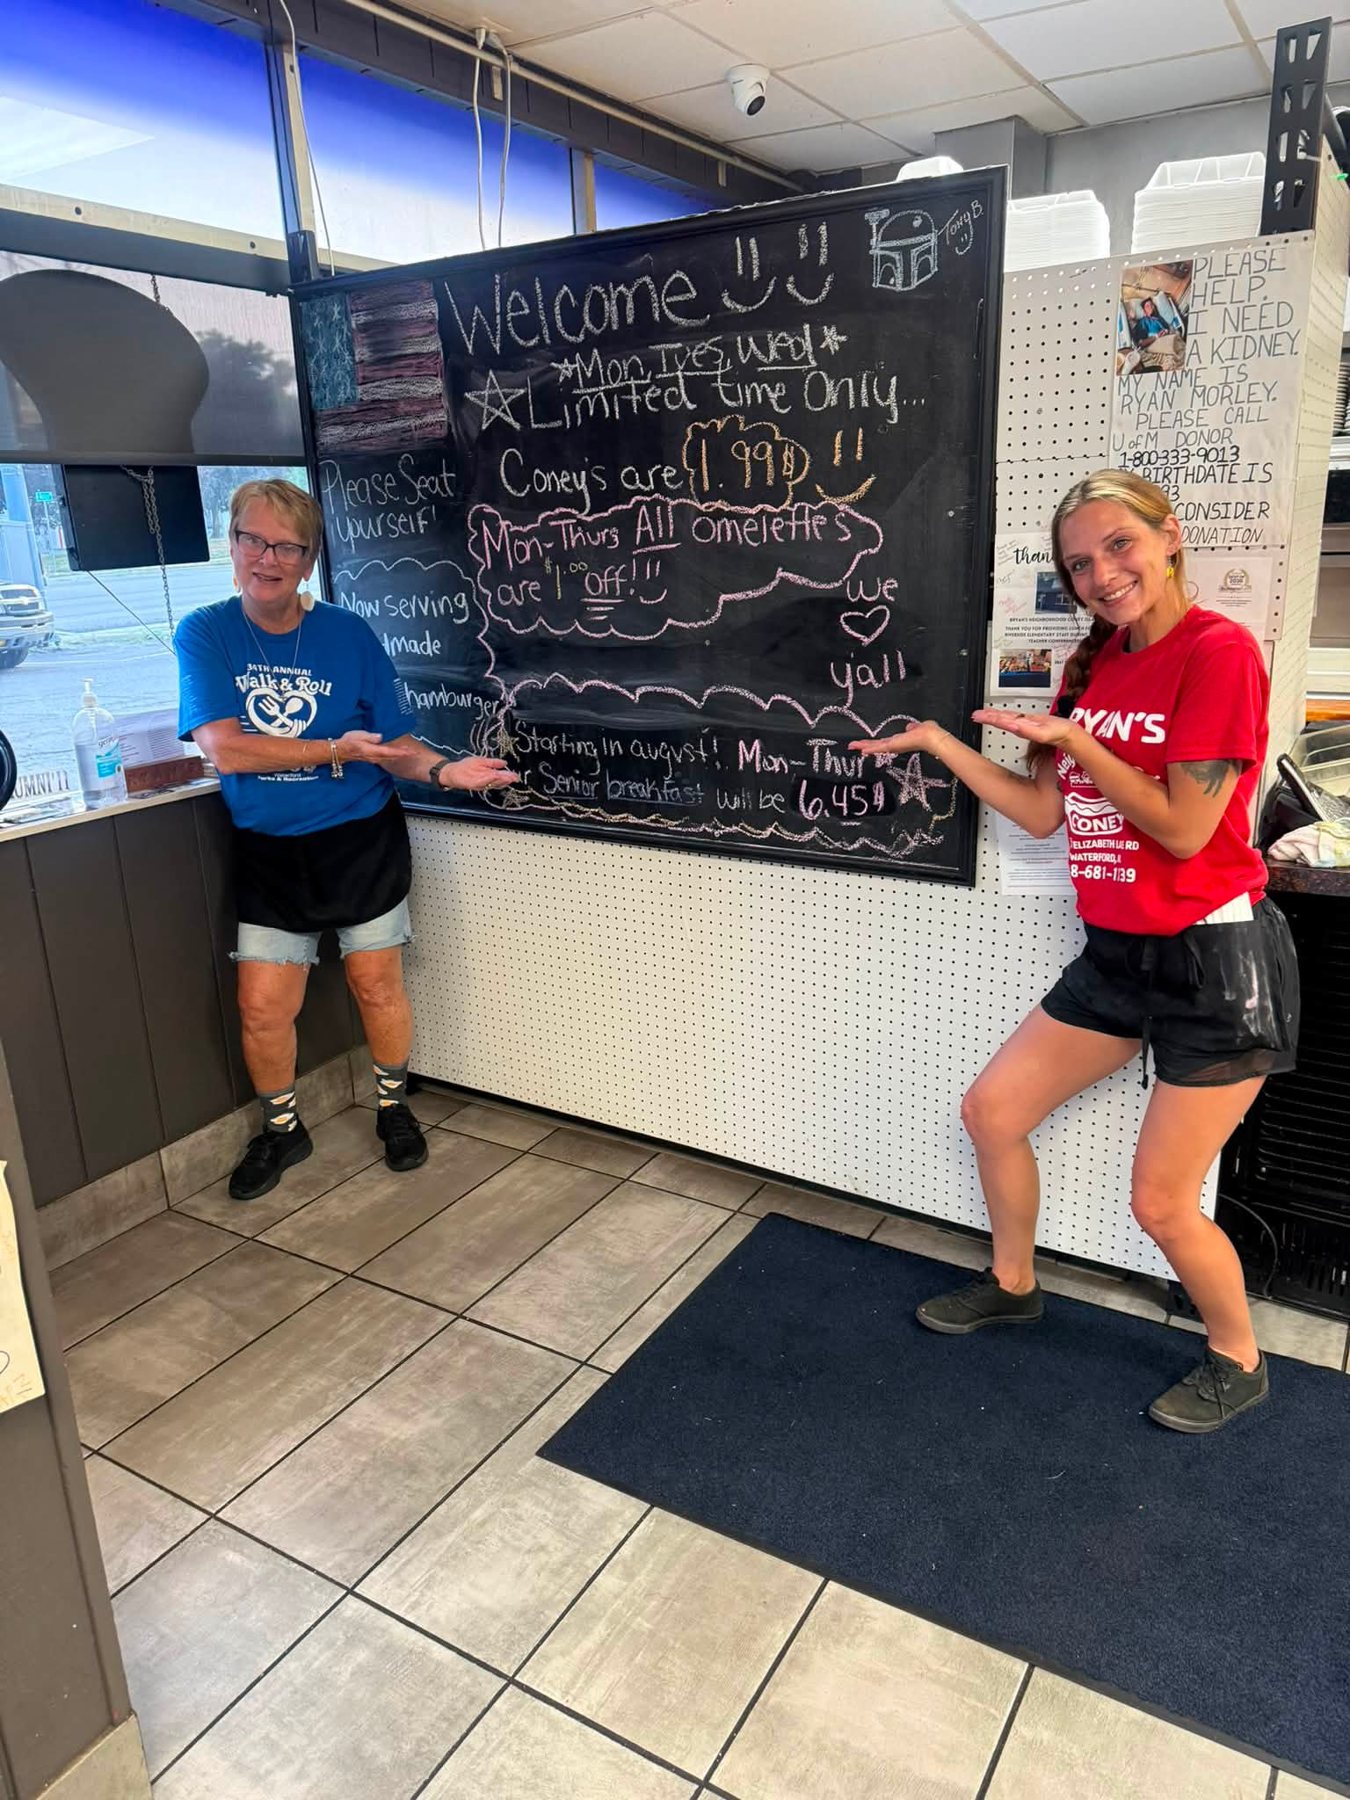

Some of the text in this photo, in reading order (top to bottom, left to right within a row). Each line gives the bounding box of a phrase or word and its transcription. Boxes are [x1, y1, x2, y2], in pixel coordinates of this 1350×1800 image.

[1193, 247, 1287, 279] PLEASE
[1190, 276, 1269, 308] HELP.
[445, 270, 711, 355] Welcome
[1189, 301, 1294, 335] I NEED
[1186, 329, 1300, 367] A KIDNEY.
[1118, 363, 1248, 396] MY NAME IS
[527, 368, 698, 430] Limited
[711, 362, 792, 414] time
[1120, 391, 1175, 415] RYAN
[1135, 406, 1269, 431] PLEASE CALL
[1175, 427, 1233, 449] DONOR
[1118, 445, 1240, 468] 1-800-333-9013
[319, 454, 456, 515] Please Seat
[500, 448, 607, 514] Coney's
[621, 464, 684, 491] are
[1143, 462, 1273, 484] BIRTHDATE IS
[1161, 484, 1180, 501] 93
[1174, 501, 1270, 522] CONSIDER
[636, 505, 675, 545] All
[692, 510, 852, 547] omelettes
[1180, 526, 1264, 545] DONATION
[1013, 546, 1056, 565] than
[497, 579, 542, 606] are
[272, 666, 313, 677] ANNUAL
[280, 678, 293, 691] &
[295, 676, 332, 696] Roll
[1069, 707, 1166, 744] RYAN'S
[517, 720, 600, 775] Starting
[760, 788, 786, 814] be
[1071, 813, 1124, 832] CONEY
[1125, 841, 1140, 850] RD
